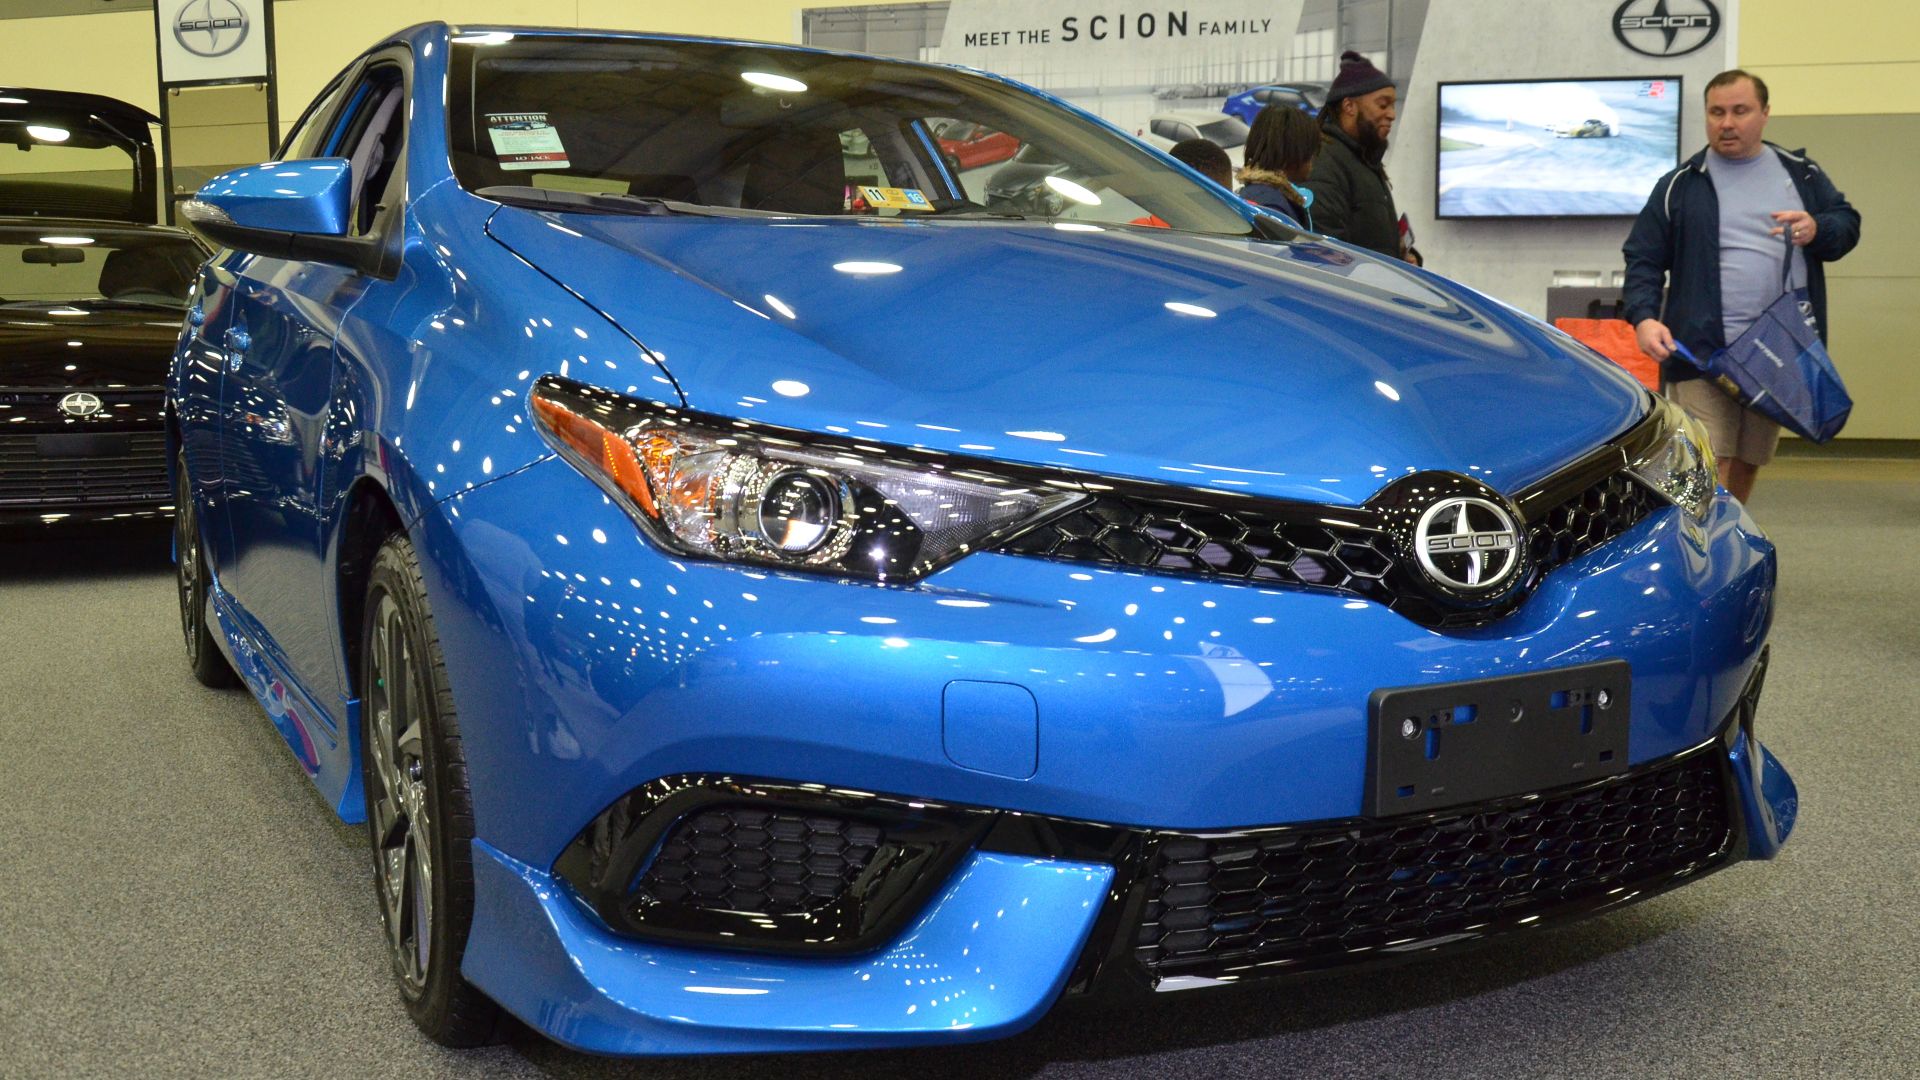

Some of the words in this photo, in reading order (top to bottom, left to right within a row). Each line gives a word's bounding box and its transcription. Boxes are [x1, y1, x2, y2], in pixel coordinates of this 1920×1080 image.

[179, 18, 242, 31] SCION
[1620, 15, 1712, 28] SCION
[965, 31, 1011, 47] MEET
[1018, 29, 1050, 45] THE
[1061, 11, 1188, 42] SCION
[1199, 19, 1271, 36] FAMILY
[489, 114, 547, 123] ATTENTION
[868, 189, 886, 201] 11
[1428, 533, 1514, 551] SCION
